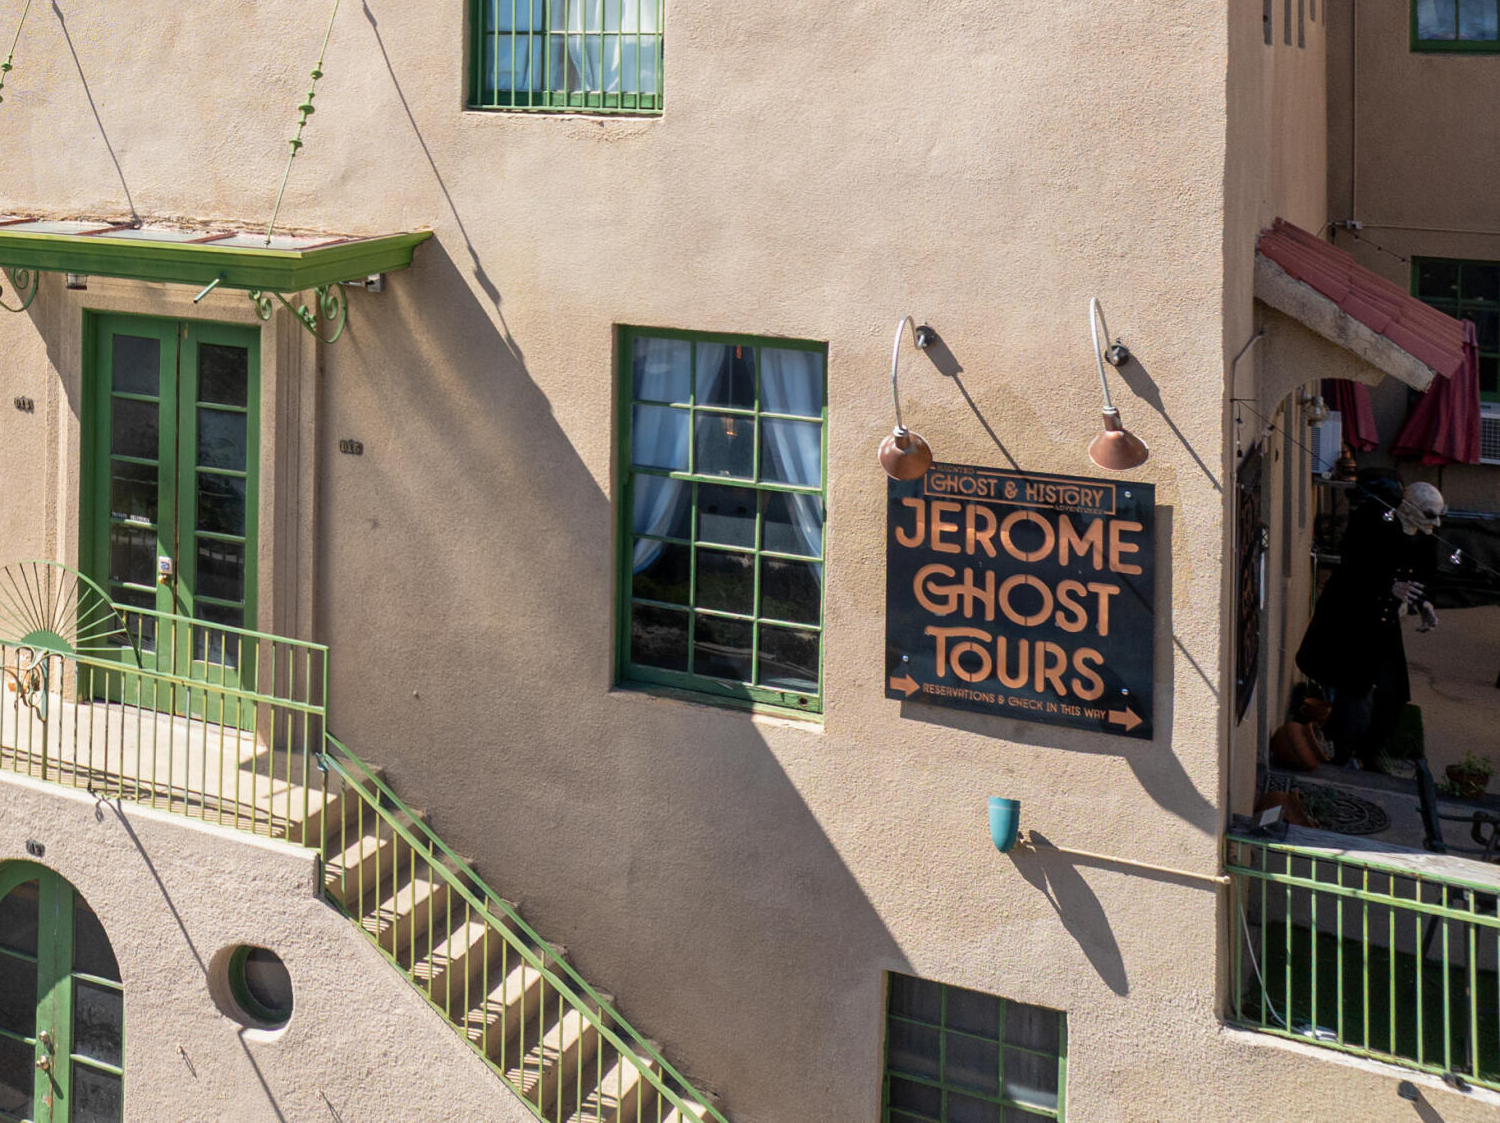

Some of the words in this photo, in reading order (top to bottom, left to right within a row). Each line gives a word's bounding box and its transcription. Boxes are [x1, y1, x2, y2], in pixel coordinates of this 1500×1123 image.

[931, 474, 998, 496] GHOST
[1004, 481, 1018, 499] &
[1025, 483, 1104, 507] HISTORY
[895, 497, 1143, 576] JEROME
[913, 563, 1120, 637] GHOST
[924, 625, 1105, 701] TOURS
[923, 683, 995, 704] RESERVATIONS
[1008, 696, 1043, 712] CHECK
[1046, 701, 1057, 714] IN
[1061, 703, 1080, 718] THIS
[1084, 707, 1106, 720] WAY
